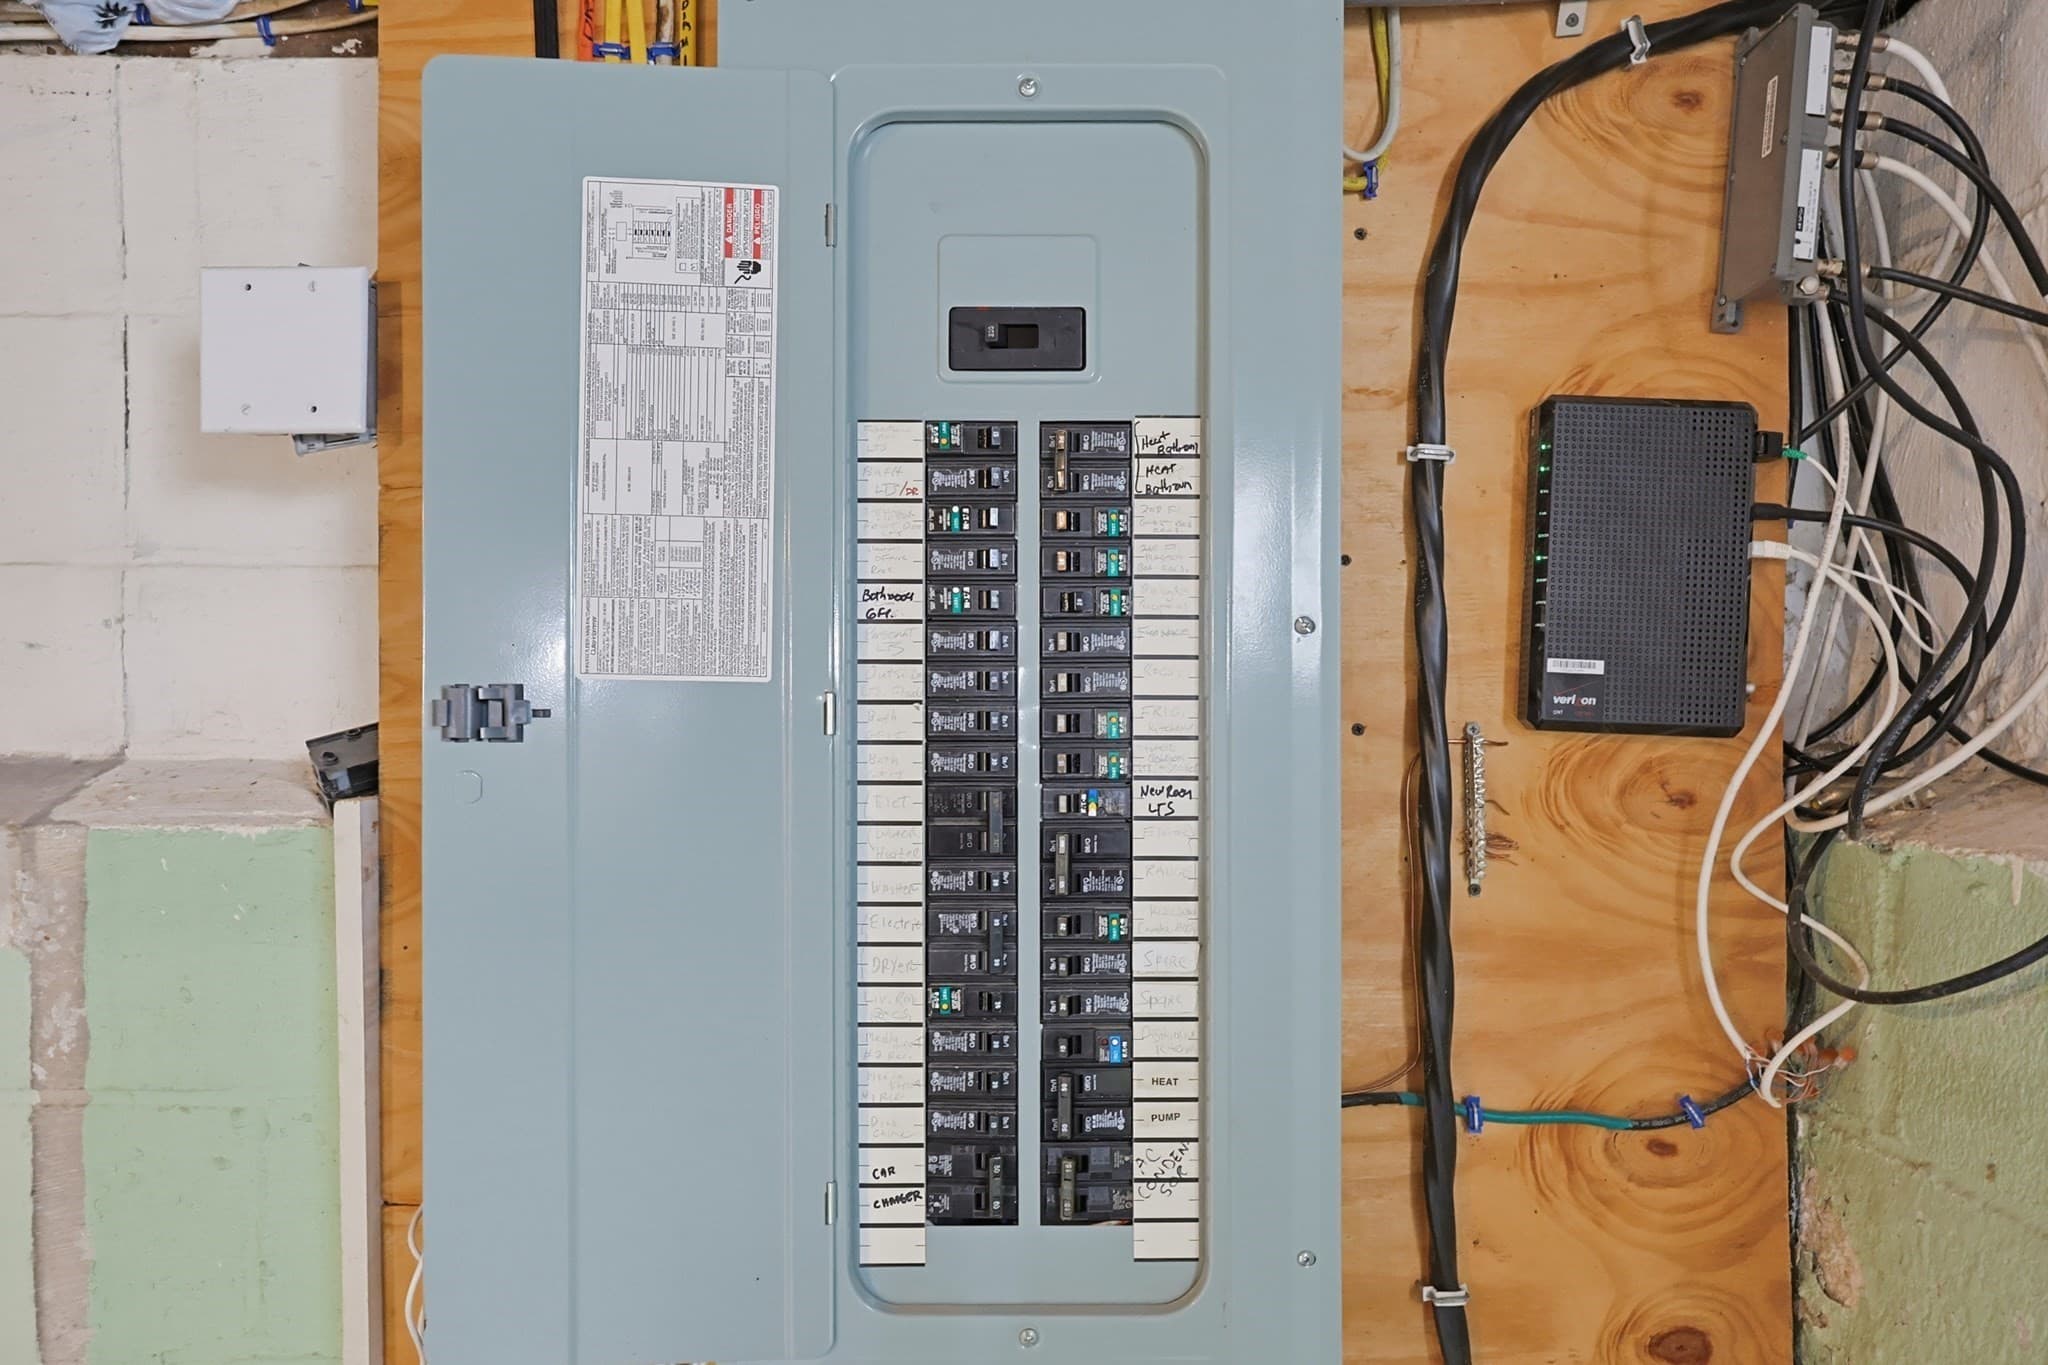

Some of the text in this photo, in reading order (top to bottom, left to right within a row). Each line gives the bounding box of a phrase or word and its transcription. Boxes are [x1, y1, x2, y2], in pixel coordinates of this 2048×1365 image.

[754, 204, 762, 235] PELIGRO
[1140, 785, 1165, 797] New
[1151, 1077, 1179, 1086] HEAT
[1151, 1112, 1181, 1123] PUMP
[872, 1166, 896, 1180] CAR
